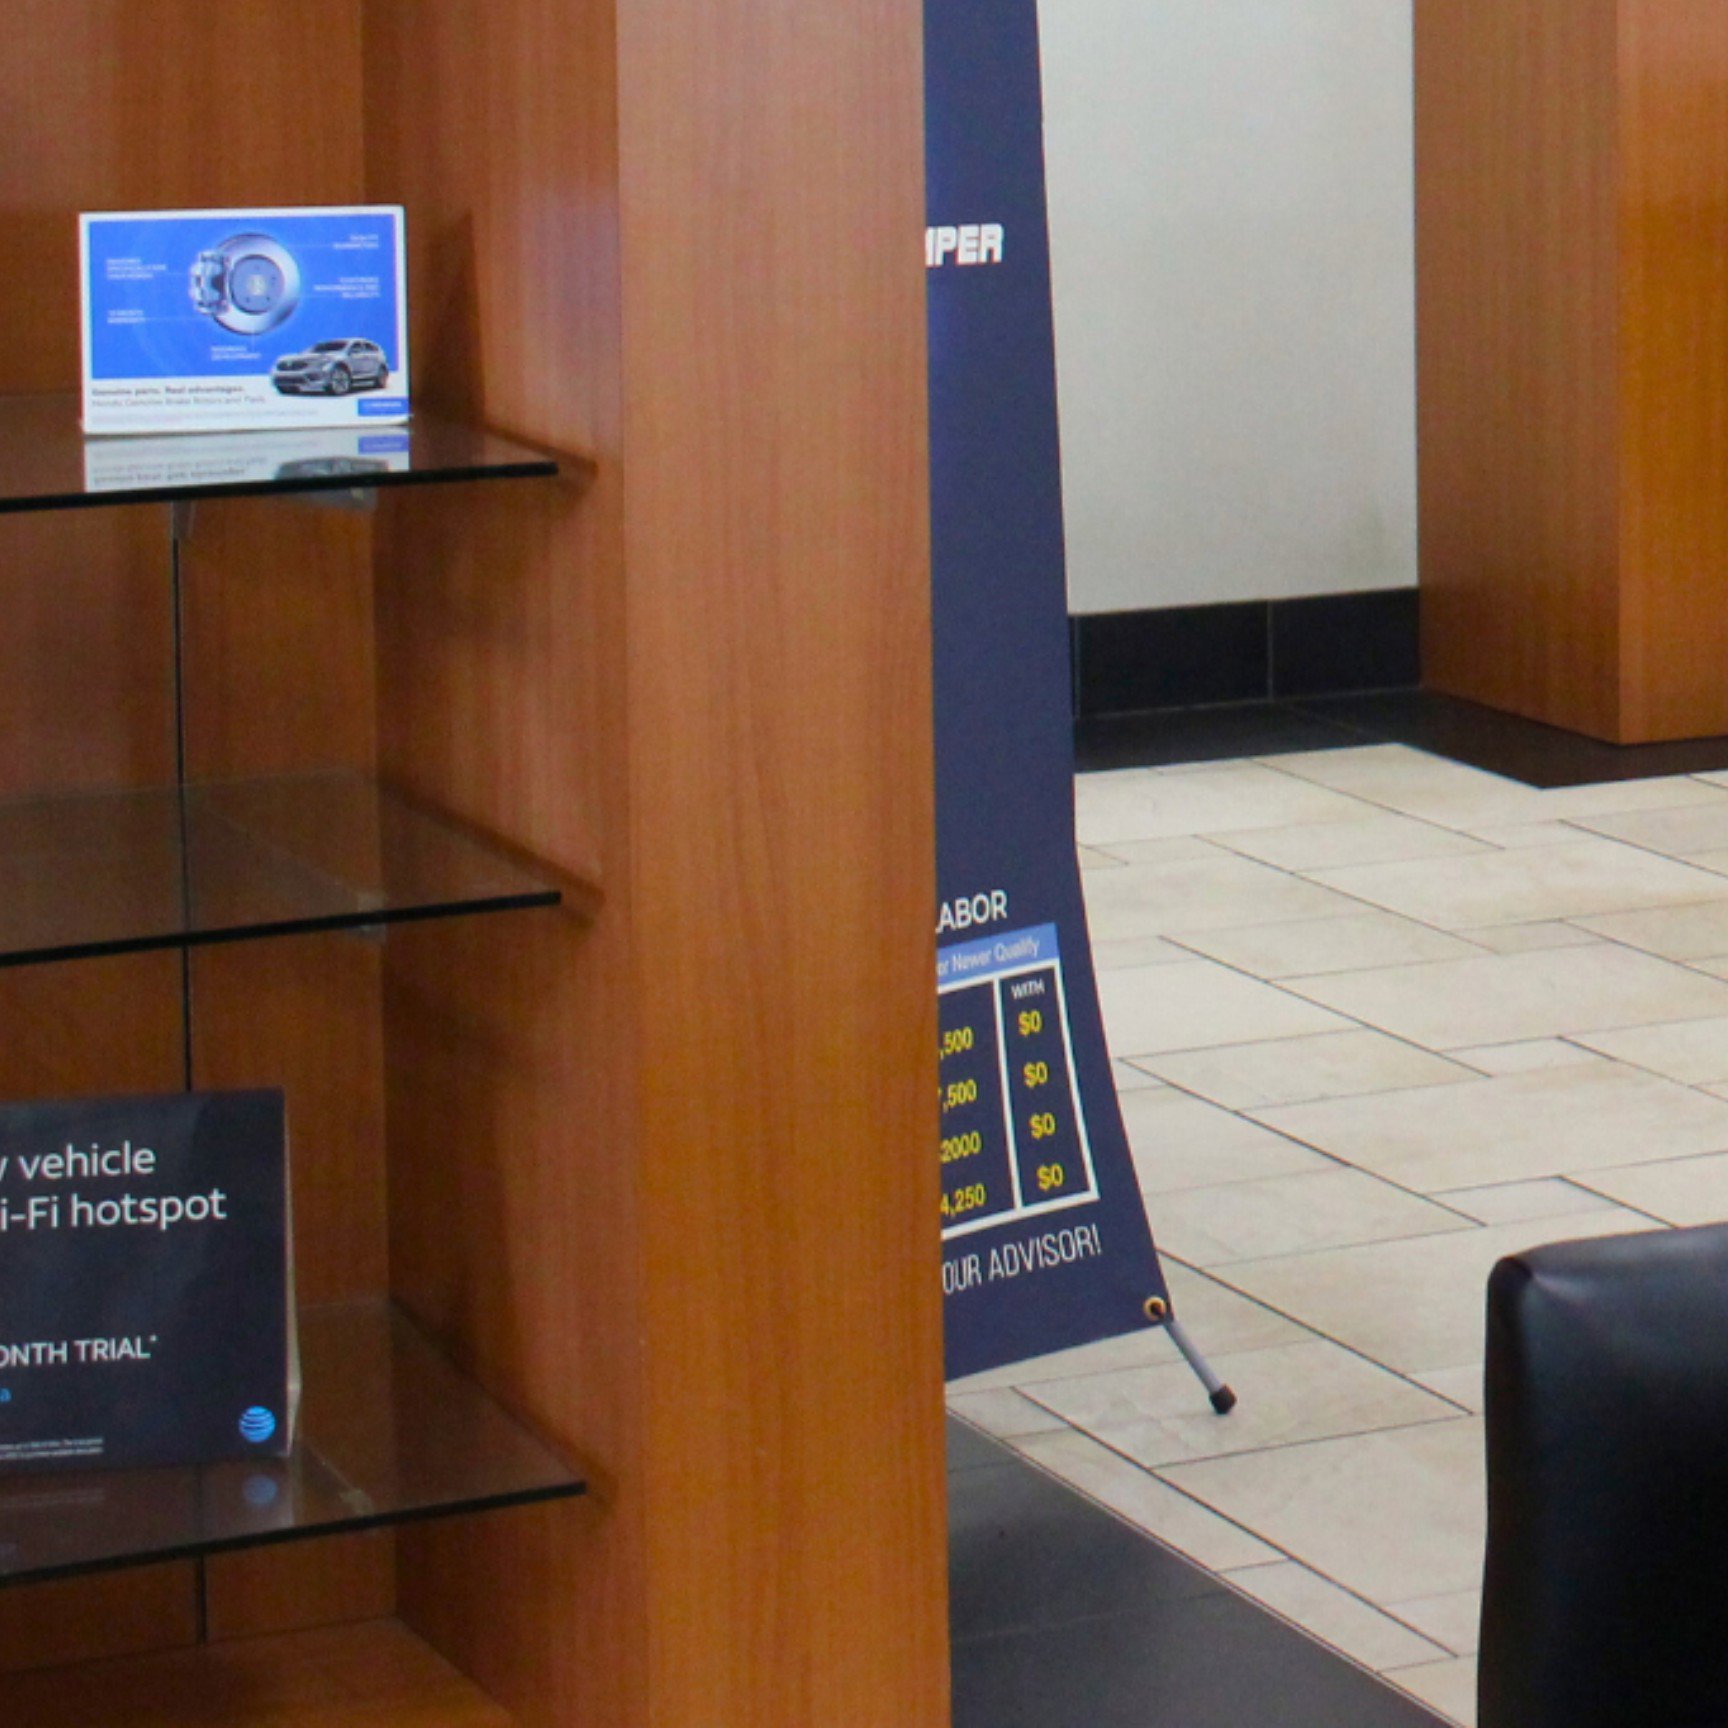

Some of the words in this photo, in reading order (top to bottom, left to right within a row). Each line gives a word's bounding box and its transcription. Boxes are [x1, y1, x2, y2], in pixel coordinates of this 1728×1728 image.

[935, 889, 1008, 934] ABOR
[1010, 979, 1045, 1000] WITH
[939, 1026, 974, 1061] ,500
[1017, 1010, 1042, 1037] $0
[938, 1079, 977, 1113] ,500
[1023, 1061, 1049, 1089] $0
[18, 1140, 156, 1181] vehicle
[940, 1130, 982, 1164] 2000
[1029, 1112, 1056, 1140] $0
[0, 1195, 59, 1232] i-Fi
[71, 1187, 228, 1232] hotspot
[940, 1183, 986, 1217] 4,250
[1036, 1163, 1064, 1192] $0
[942, 1254, 982, 1296] OUR
[988, 1223, 1102, 1282] ADVISOR!
